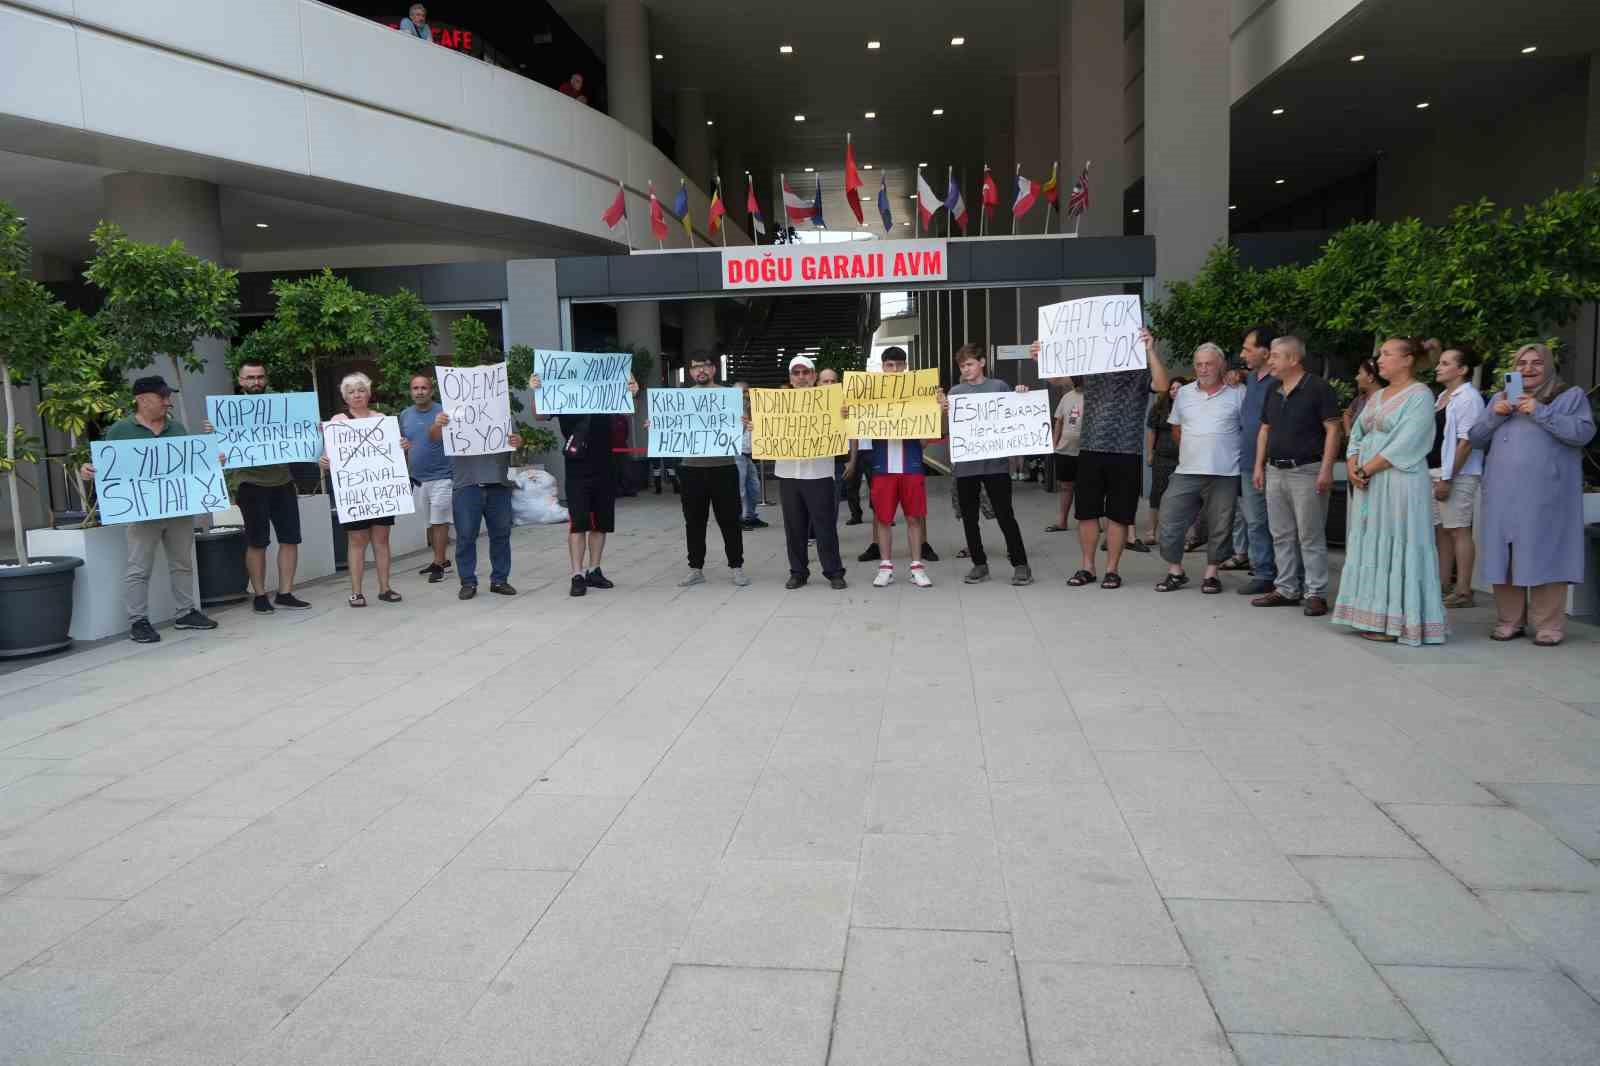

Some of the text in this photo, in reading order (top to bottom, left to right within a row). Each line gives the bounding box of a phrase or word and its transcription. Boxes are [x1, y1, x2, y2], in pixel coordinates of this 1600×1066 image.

[728, 250, 942, 284] DOĞU GARAJI AVM
[1043, 299, 1138, 336] VAAT ÇOK
[1104, 332, 1143, 370] YOK
[583, 355, 633, 383] YANDIK
[443, 366, 508, 402] ÖDEME
[215, 397, 289, 427] KAPALI
[453, 403, 494, 429] ÇOK
[691, 392, 726, 413] VAR!
[847, 400, 913, 420] ADALET
[952, 396, 1006, 423] ESNAF
[1004, 402, 1048, 419] BURADA
[698, 412, 736, 429] VAR!
[857, 412, 938, 438] ARAMAYIN
[228, 440, 317, 465] AÇTIRIN
[658, 428, 742, 456] HİZMET YOK
[100, 439, 211, 482] 2 YILDIR
[339, 486, 371, 506] HALK
